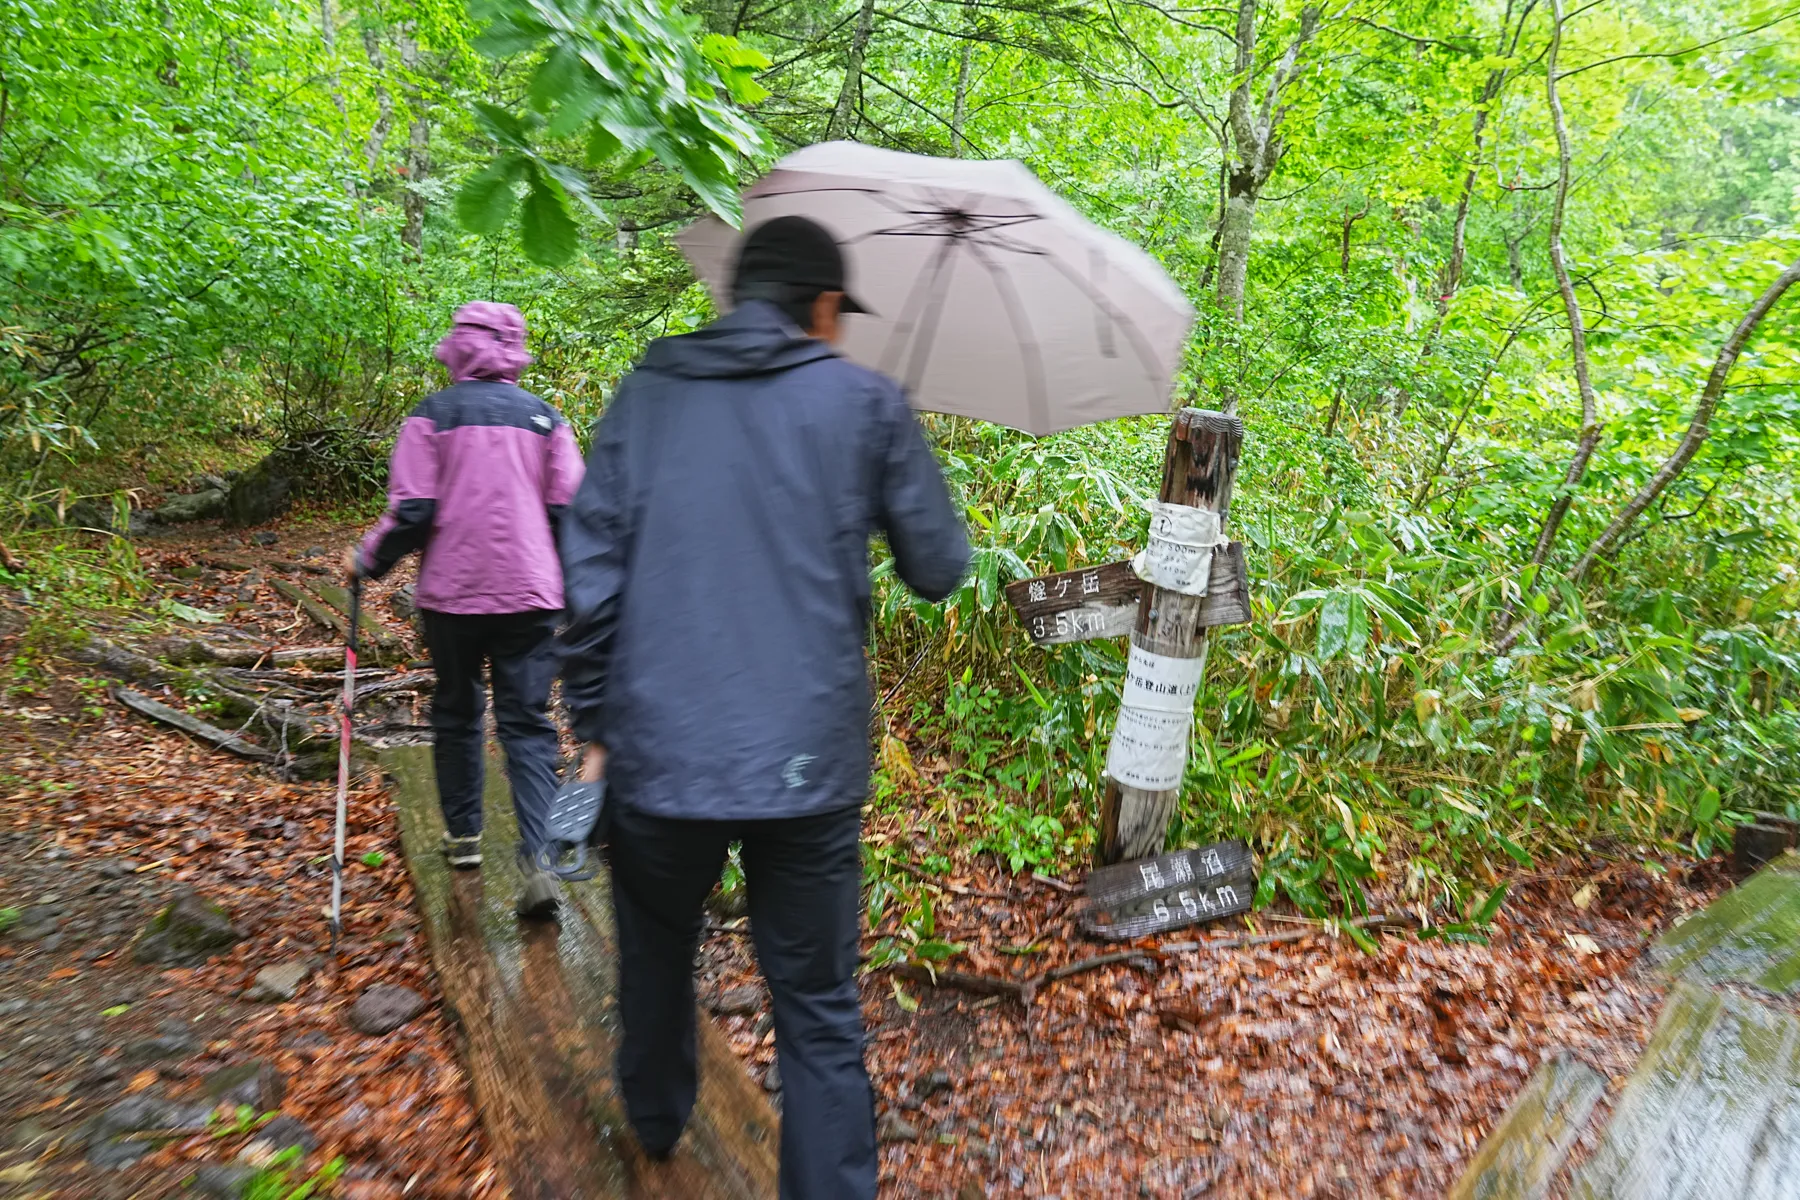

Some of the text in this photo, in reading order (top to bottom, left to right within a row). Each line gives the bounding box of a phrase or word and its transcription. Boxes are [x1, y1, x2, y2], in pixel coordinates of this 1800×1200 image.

[1032, 611, 1105, 639] 3.5km
[1140, 848, 1225, 891] 尾瀬沼
